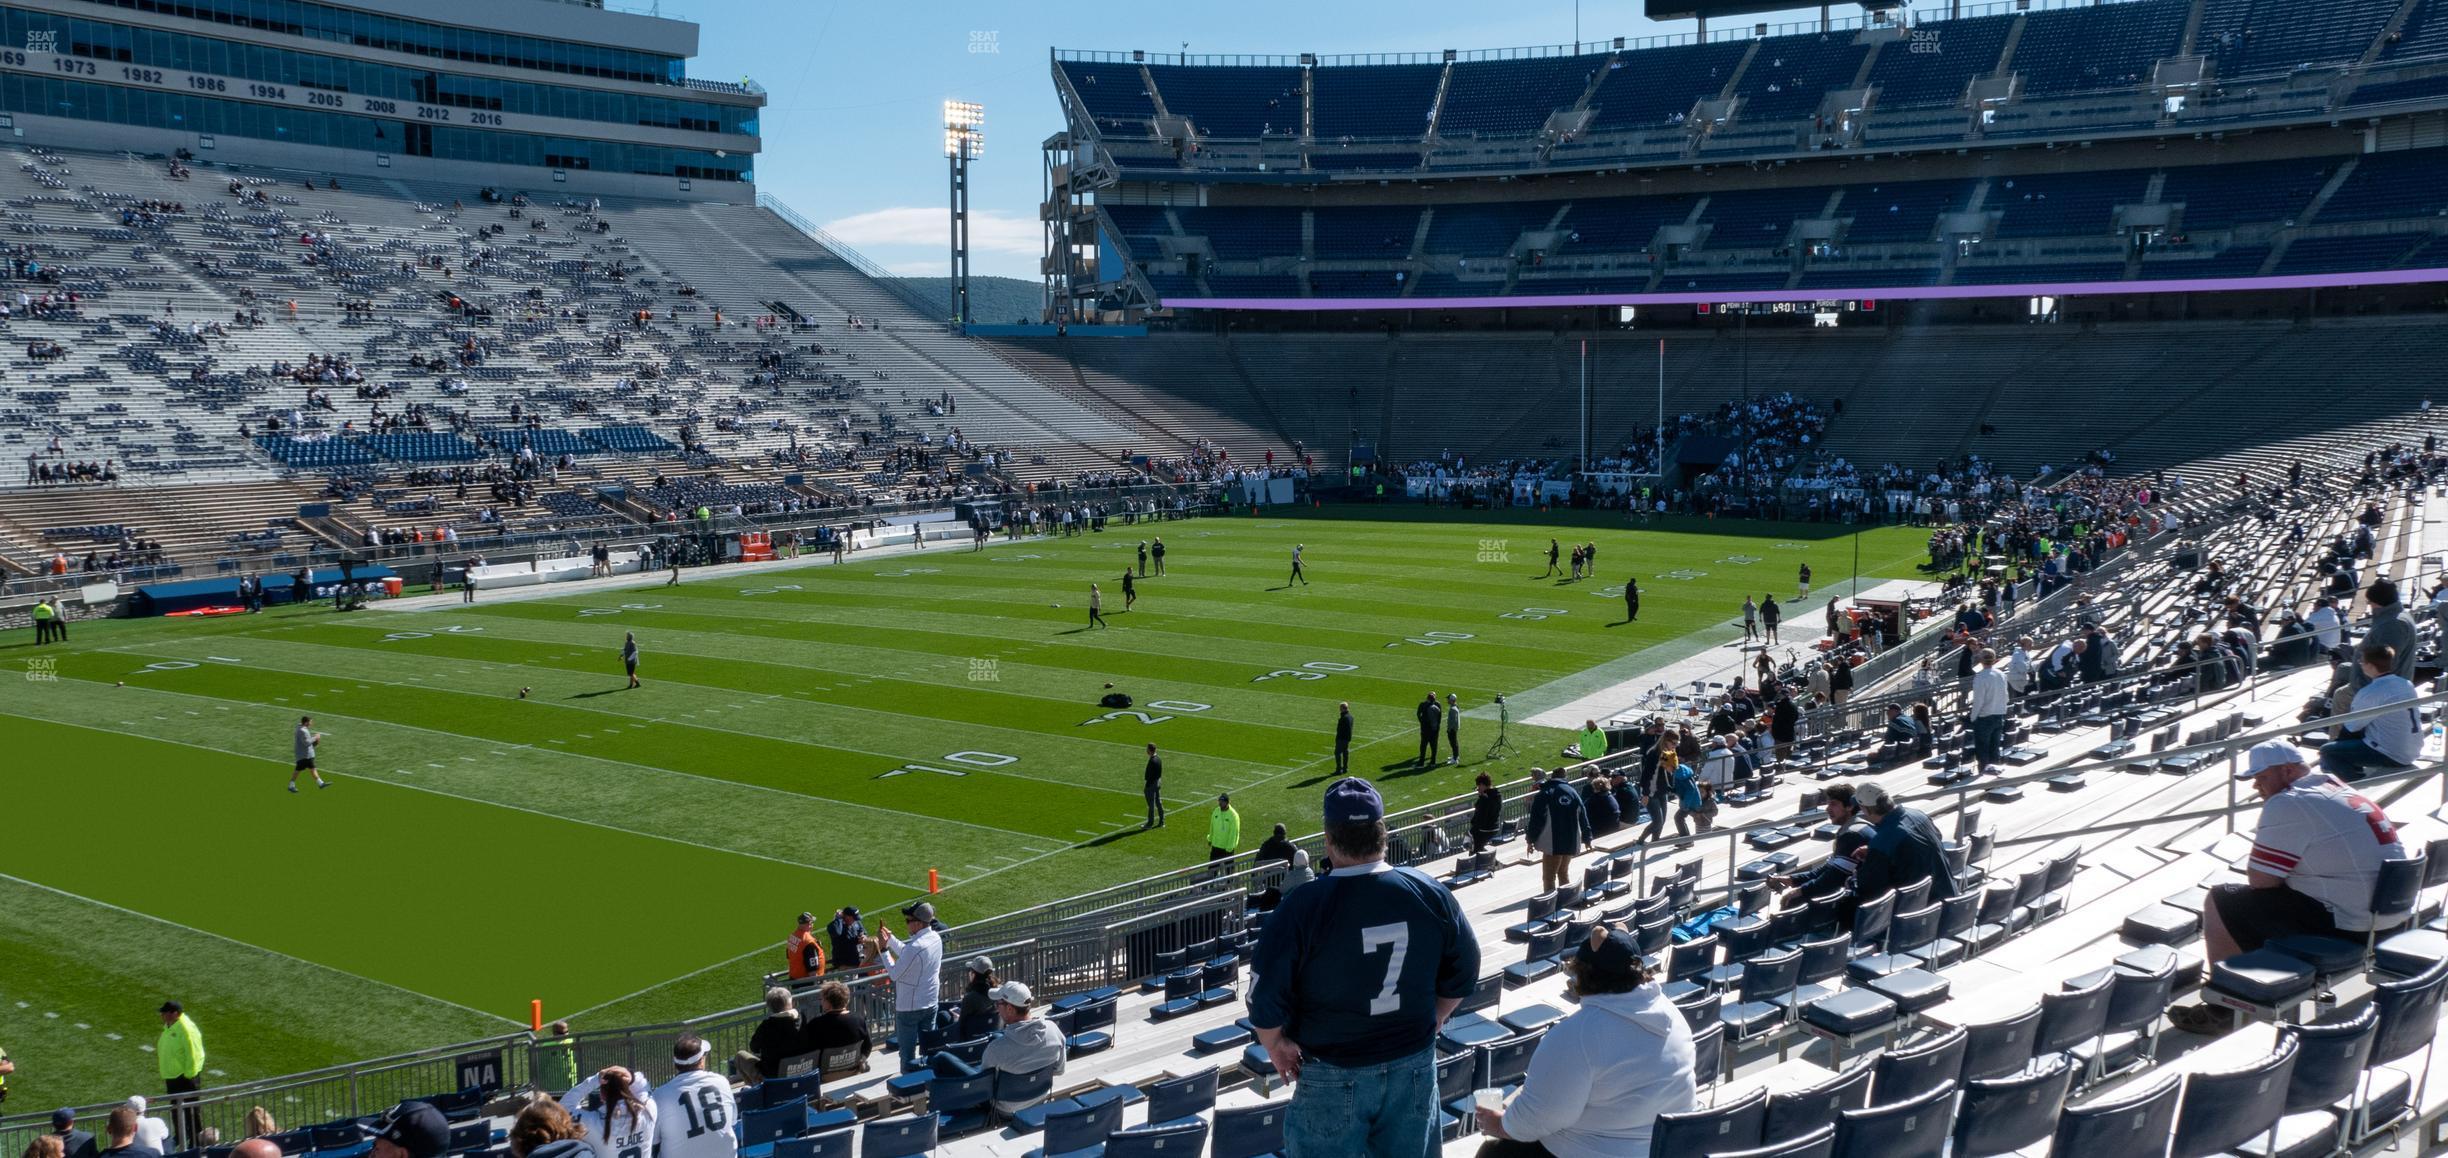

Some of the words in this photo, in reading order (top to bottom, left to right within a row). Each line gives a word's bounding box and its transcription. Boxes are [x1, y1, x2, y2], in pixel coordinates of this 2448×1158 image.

[53, 58, 97, 76] 1973
[122, 66, 163, 85] 1982
[187, 75, 226, 92] 1986
[249, 84, 286, 100] 1994
[308, 91, 344, 107] 2005
[365, 99, 397, 114] 2008
[418, 106, 450, 121] 2012
[471, 112, 503, 126] 2016
[1499, 607, 1569, 621] 50
[1404, 631, 1475, 647] 40
[1267, 661, 1360, 681] 30
[1103, 700, 1214, 726] 20
[902, 751, 1020, 777] 10
[1361, 921, 1409, 1016] 7
[463, 1063, 497, 1089] NA
[678, 1084, 727, 1139] 18
[616, 1131, 645, 1149] SLADE
